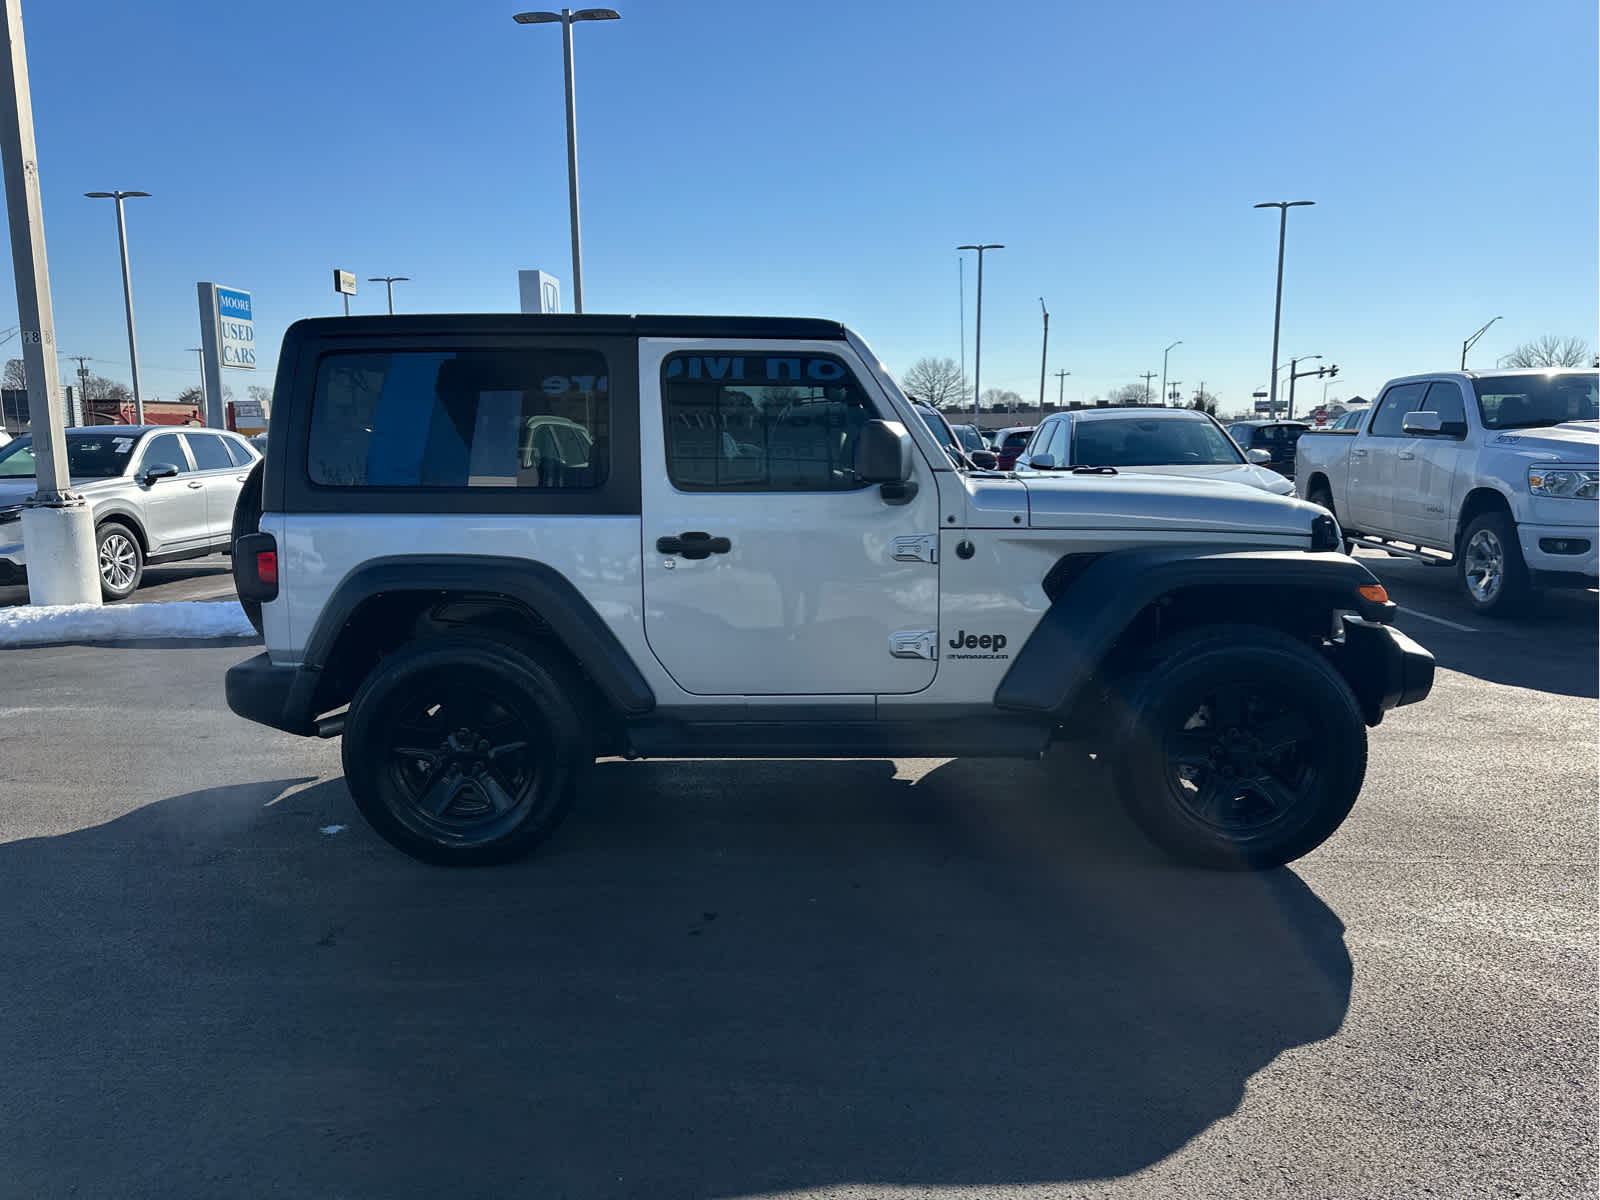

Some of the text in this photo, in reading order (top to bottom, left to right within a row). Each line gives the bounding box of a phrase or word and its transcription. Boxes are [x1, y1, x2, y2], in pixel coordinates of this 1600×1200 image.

[221, 295, 250, 312] MOORE
[222, 321, 254, 342] USED
[224, 345, 256, 364] CARS
[949, 630, 1007, 652] Jeep
